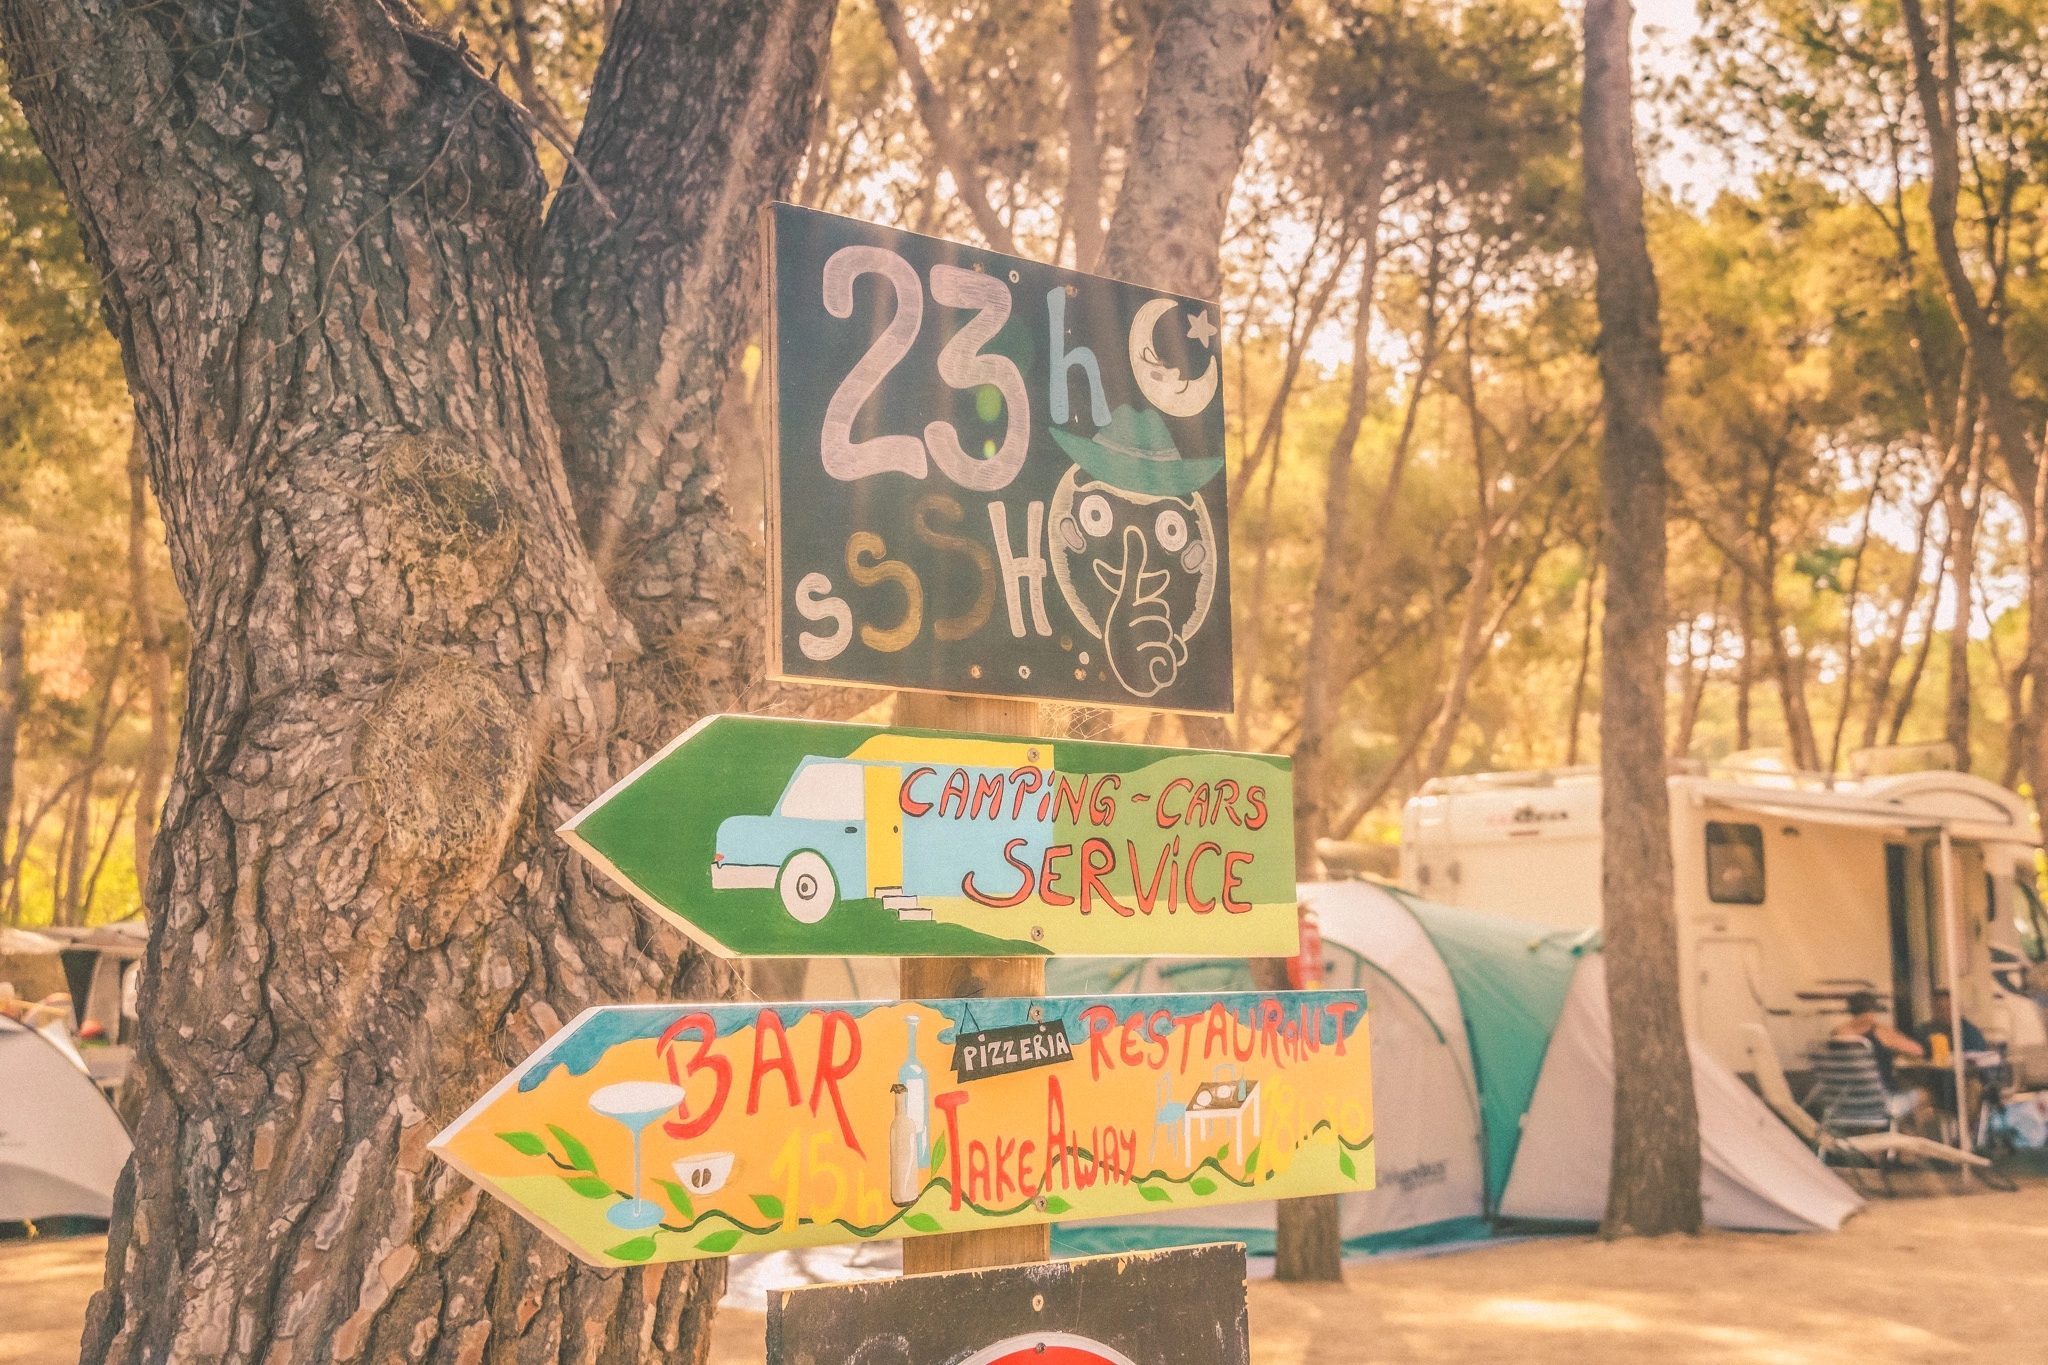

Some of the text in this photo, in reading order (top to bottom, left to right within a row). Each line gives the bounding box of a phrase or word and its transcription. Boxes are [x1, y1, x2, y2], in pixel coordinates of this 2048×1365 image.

[656, 1008, 867, 1161] BAR
[1078, 998, 1359, 1082] RESTAURANT
[770, 1126, 884, 1234] 15h
